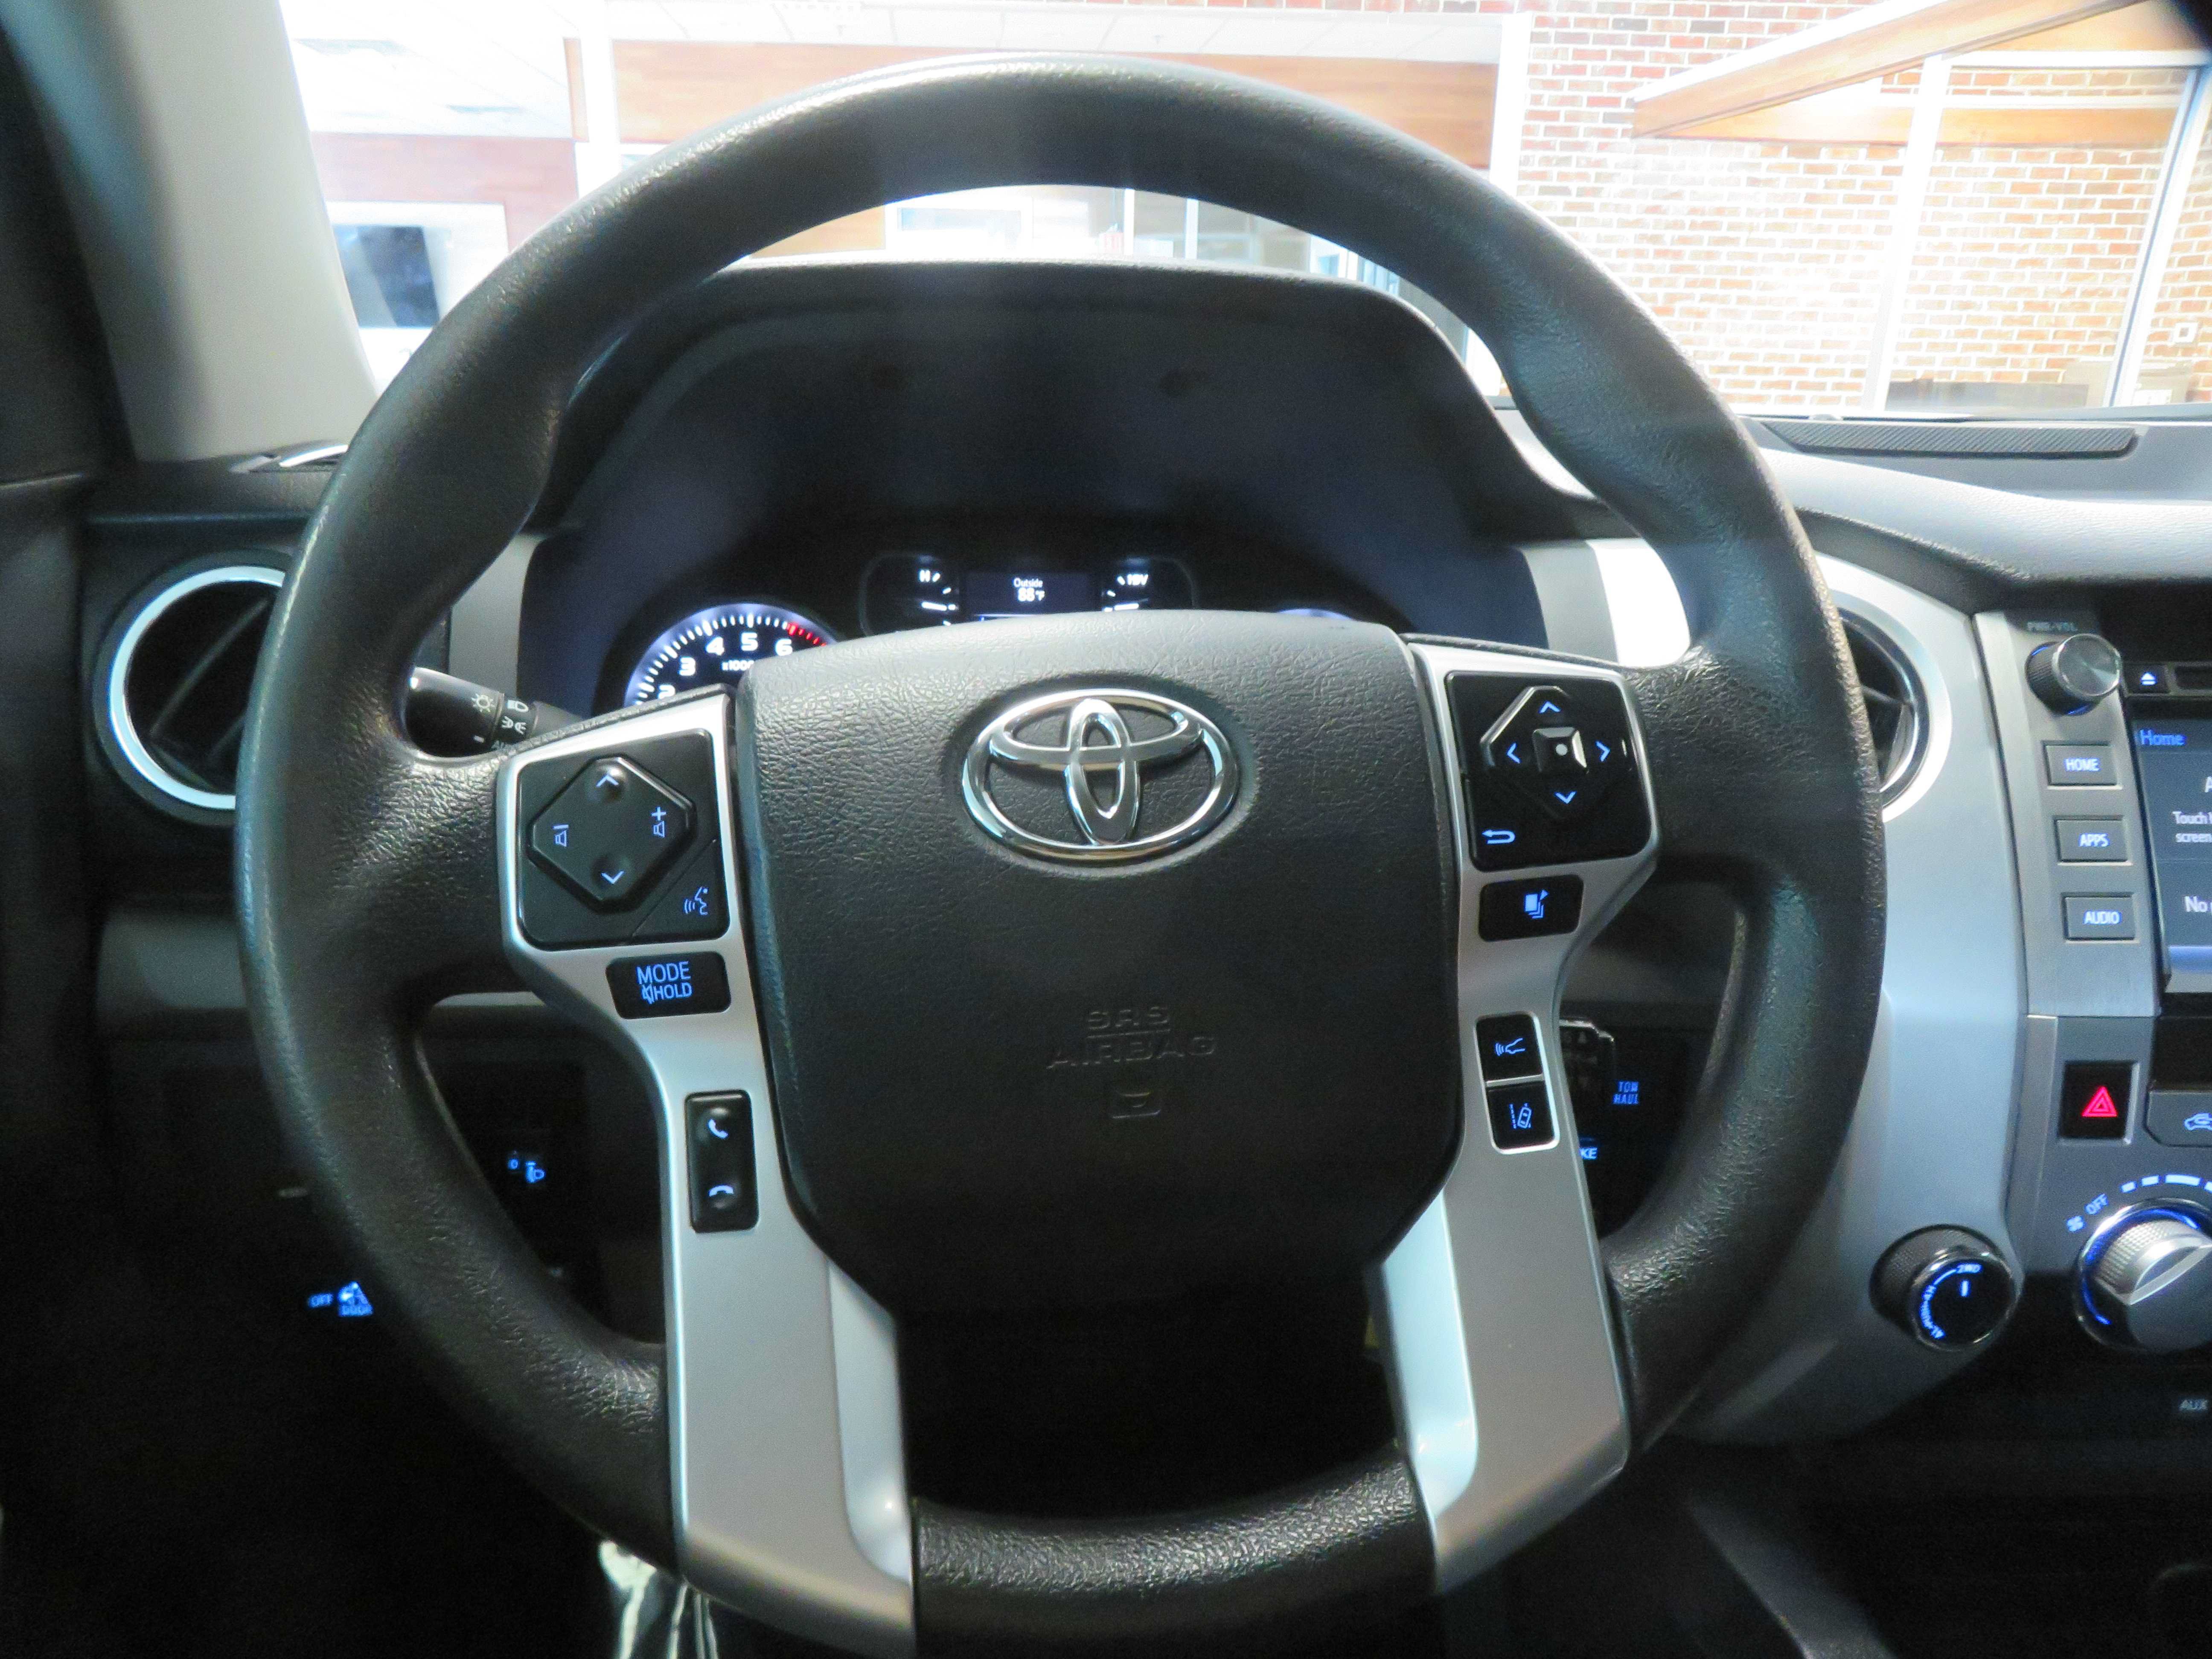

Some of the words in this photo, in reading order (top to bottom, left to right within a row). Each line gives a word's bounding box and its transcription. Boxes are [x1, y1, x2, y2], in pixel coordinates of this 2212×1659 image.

[920, 570, 930, 582] H
[1013, 577, 1043, 588] Outside
[705, 637, 725, 655] 4
[741, 632, 758, 651] 5
[775, 638, 793, 656] 6
[679, 656, 696, 676] 3
[658, 684, 676, 700] 2
[2139, 729, 2186, 746] Home
[2064, 757, 2100, 771] HOME
[2172, 811, 2208, 824] Touch
[2079, 832, 2110, 847] APPS
[2184, 896, 2207, 913] No
[2084, 911, 2121, 925] AUDIO
[636, 961, 691, 985] MODE
[654, 982, 692, 1001] HOLD
[1087, 1005, 1170, 1030] SRS
[1045, 1036, 1217, 1070] AIRBAG
[1618, 1081, 1639, 1092] TOW
[1613, 1093, 1639, 1105] HAUL
[2085, 1193, 2108, 1215] OFF
[2179, 1399, 2208, 1411] AUX
